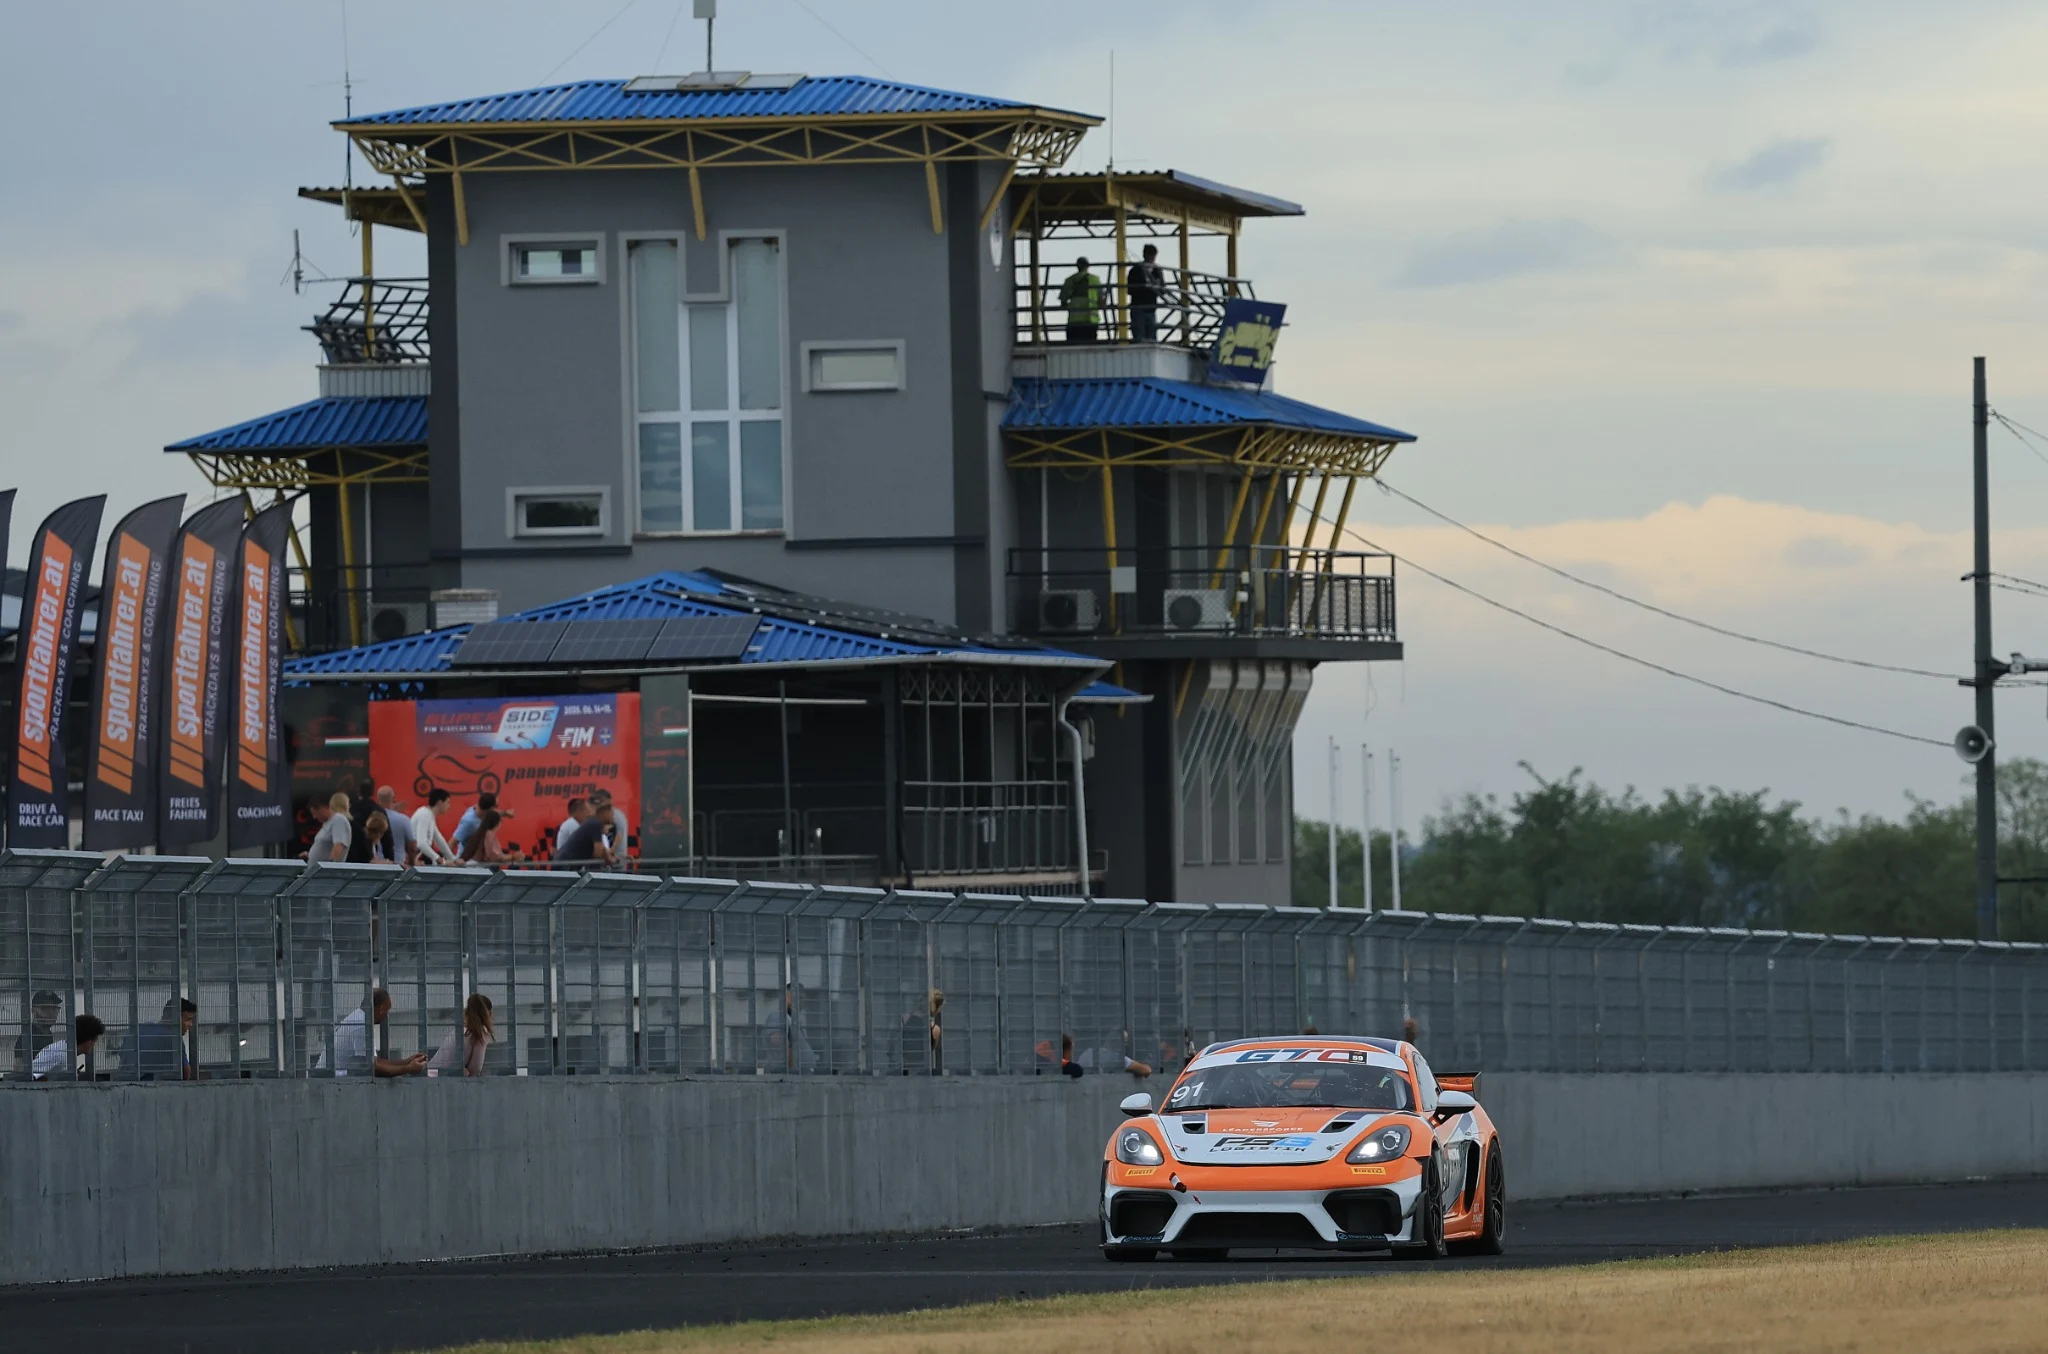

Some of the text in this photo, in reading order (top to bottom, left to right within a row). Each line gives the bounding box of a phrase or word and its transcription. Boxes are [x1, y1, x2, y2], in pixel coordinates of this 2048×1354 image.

[63, 560, 82, 639] COACHING
[143, 561, 162, 638] COACHING
[210, 560, 226, 636] COACHING
[268, 565, 280, 639] COACHING
[24, 556, 64, 742] sportfahrer.at
[107, 556, 143, 742] sportfahrer.at
[176, 557, 207, 737] sportfahrer.at
[243, 563, 264, 743] sportfahrer.at
[138, 656, 150, 741] TRACKDAYS
[204, 652, 220, 736] TRACKDAYS
[506, 709, 554, 723] SIDE
[556, 726, 595, 749] FIM
[504, 760, 619, 784] pannonia-ring
[19, 803, 57, 815] DRIVE A
[19, 815, 64, 827] RACE CAR
[94, 809, 144, 822] RACE TAXI
[169, 797, 200, 809] FREIES
[169, 808, 207, 820] FAHREN
[237, 805, 282, 819] COACHING
[1171, 1082, 1204, 1103] 91
